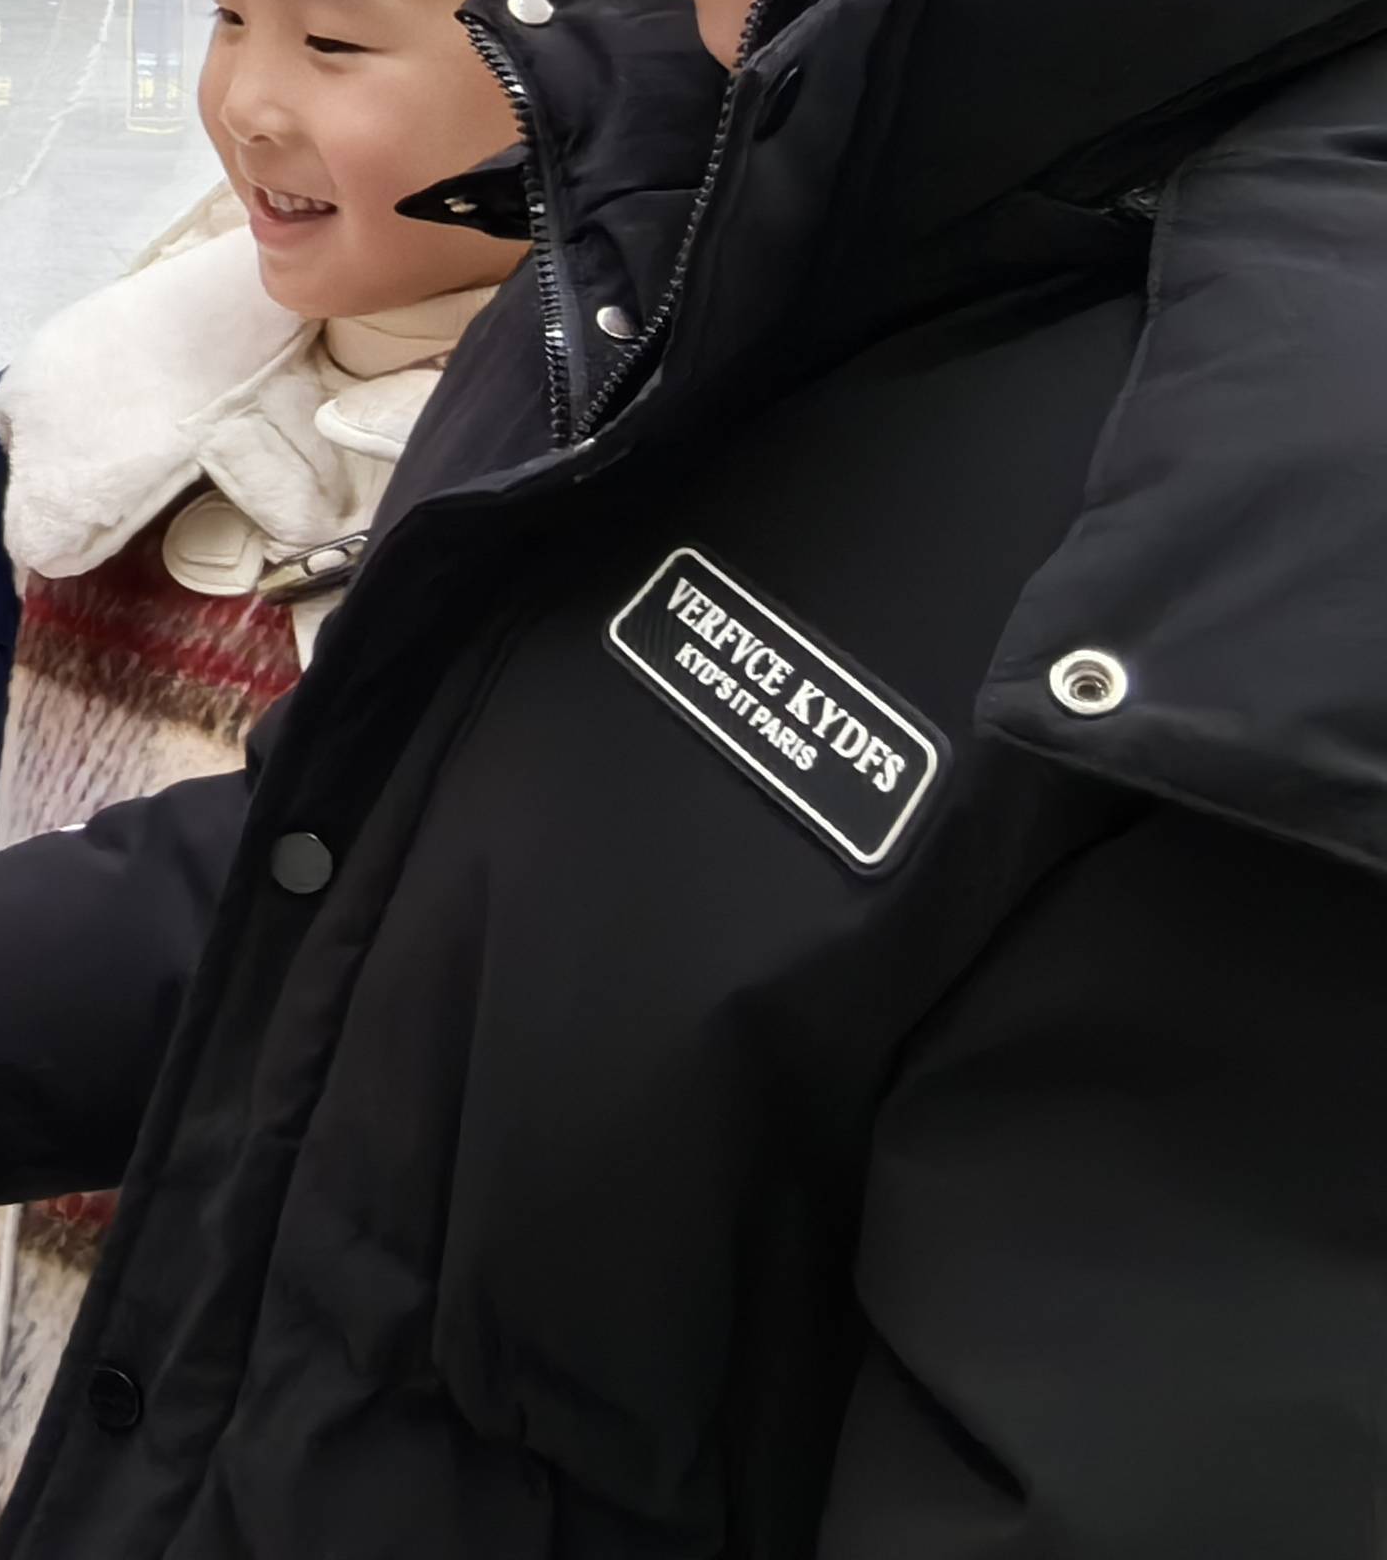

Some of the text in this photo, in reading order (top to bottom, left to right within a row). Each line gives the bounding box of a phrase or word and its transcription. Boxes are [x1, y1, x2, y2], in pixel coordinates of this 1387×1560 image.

[667, 577, 906, 793] VERFVCE KYDFS
[748, 702, 819, 772] PARIS
